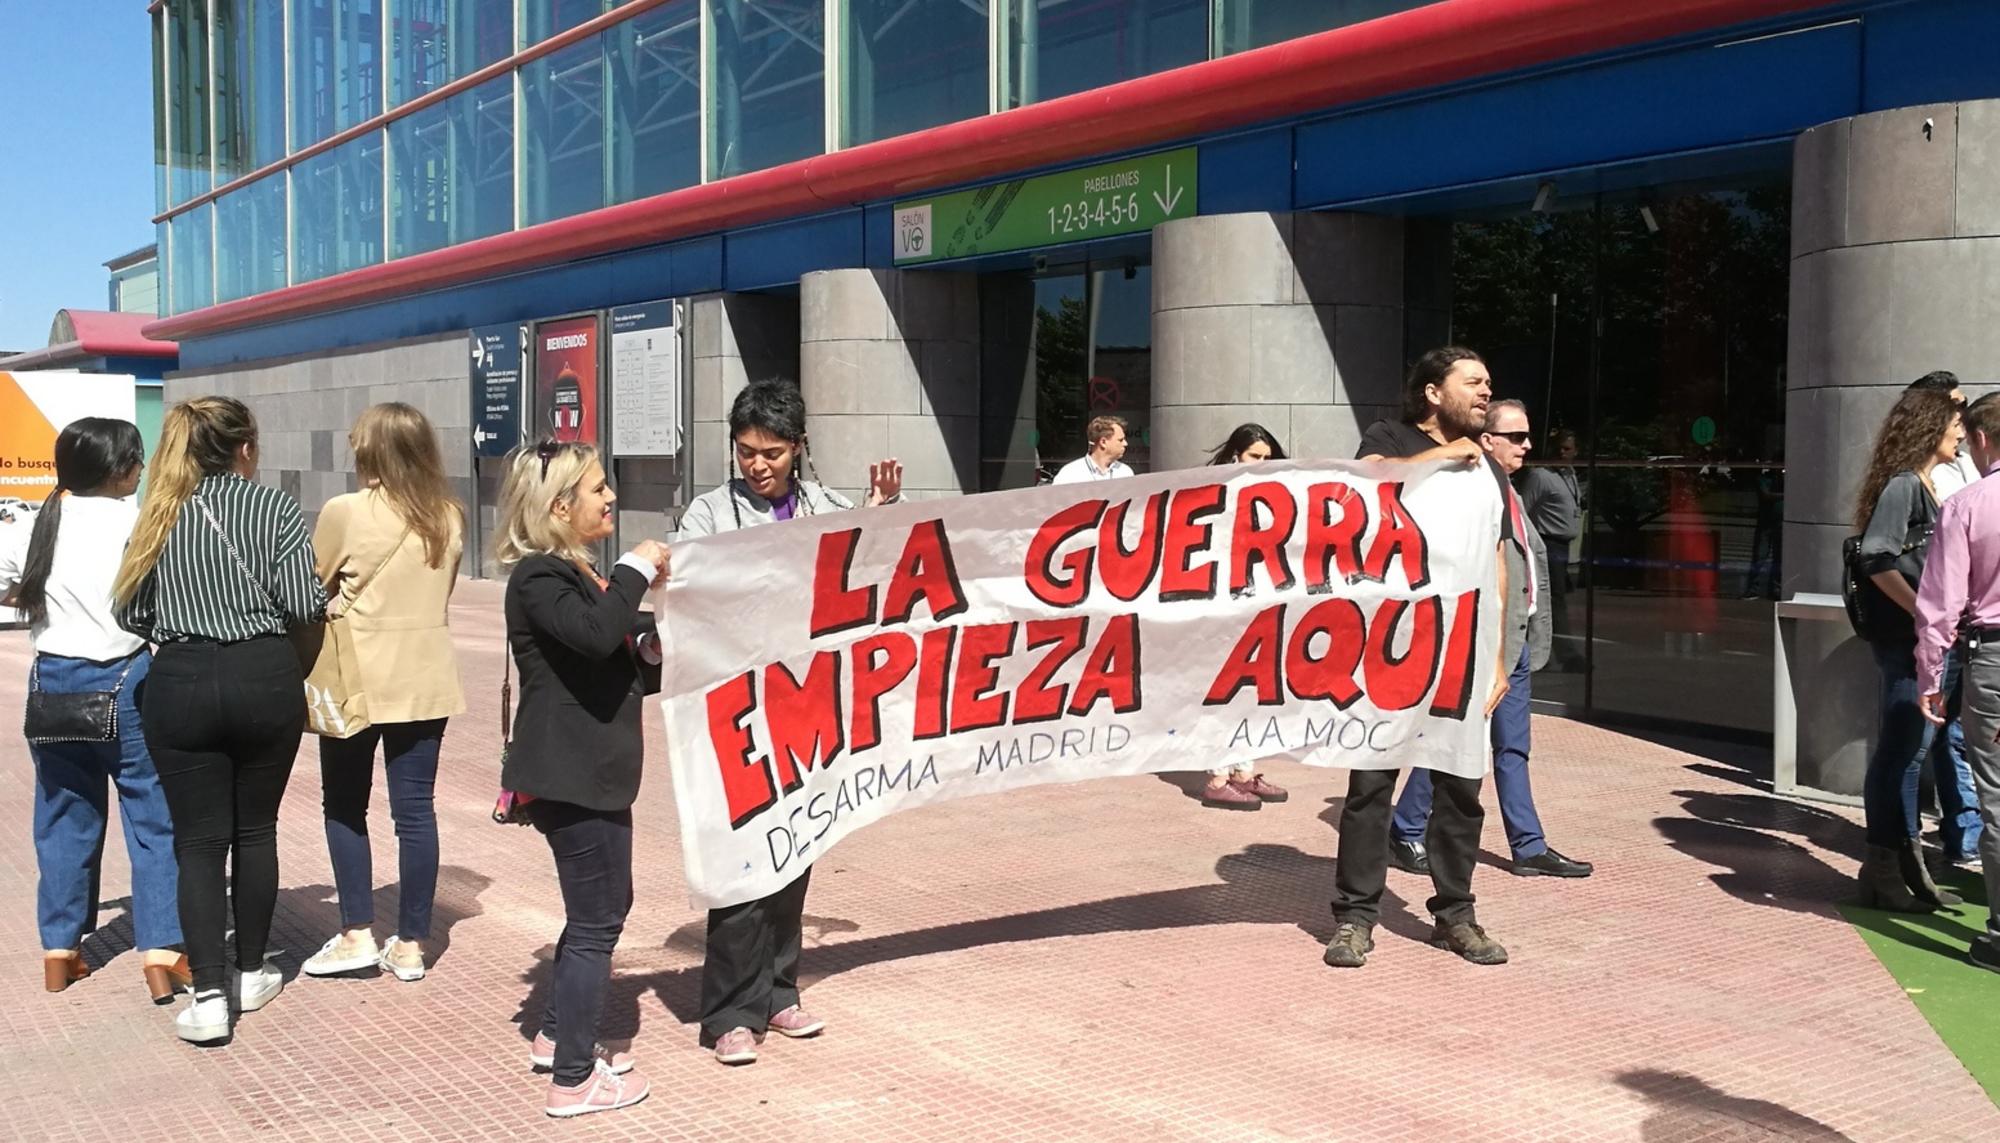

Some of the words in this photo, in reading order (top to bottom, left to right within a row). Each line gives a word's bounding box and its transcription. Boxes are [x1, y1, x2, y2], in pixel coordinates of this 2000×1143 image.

[1084, 170, 1139, 194] PABELLONES
[1047, 192, 1139, 235] 1-2-3-4-5-6
[546, 333, 588, 351] BIENVENIDOS
[0, 474, 58, 485] ncuentr
[810, 518, 969, 639] LA
[1025, 481, 1430, 608] GUERRA
[706, 613, 1141, 830] EMPIEZA
[1202, 589, 1479, 720] AQUI
[766, 755, 939, 873] DESARMA
[975, 724, 1131, 774] MADRID
